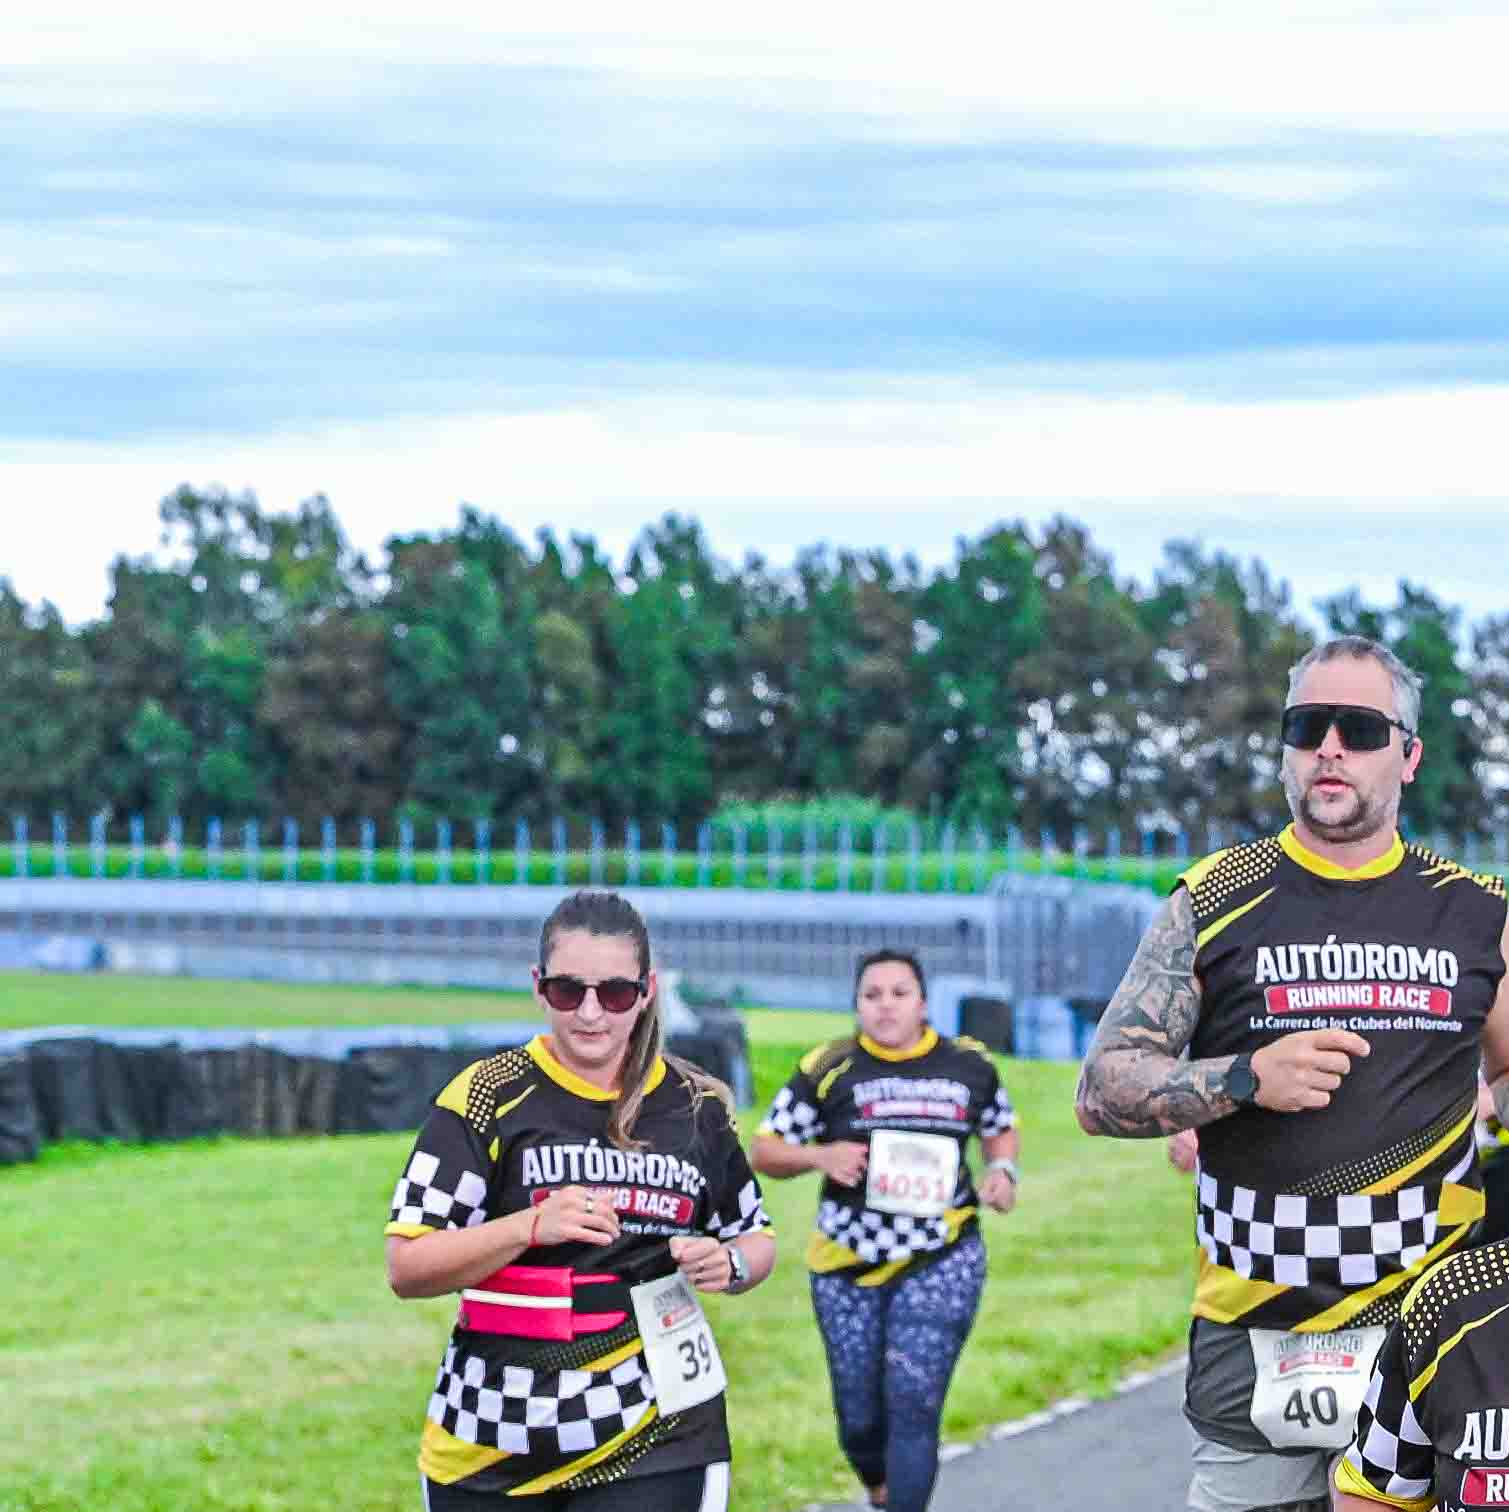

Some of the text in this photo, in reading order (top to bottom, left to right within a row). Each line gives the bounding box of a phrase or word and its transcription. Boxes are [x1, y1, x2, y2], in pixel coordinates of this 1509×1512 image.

[1254, 934, 1459, 987] AUTÓDROMO
[1286, 985, 1431, 1010] RUNNING RACE
[1249, 1015, 1264, 1030] La
[1264, 1015, 1310, 1030] Carrera
[1311, 1015, 1328, 1029] de
[1349, 1016, 1391, 1030] Clubes
[1392, 1016, 1414, 1030] del
[634, 1188, 681, 1219] RACE
[678, 1332, 712, 1382] 39
[1283, 1385, 1339, 1429] 40
